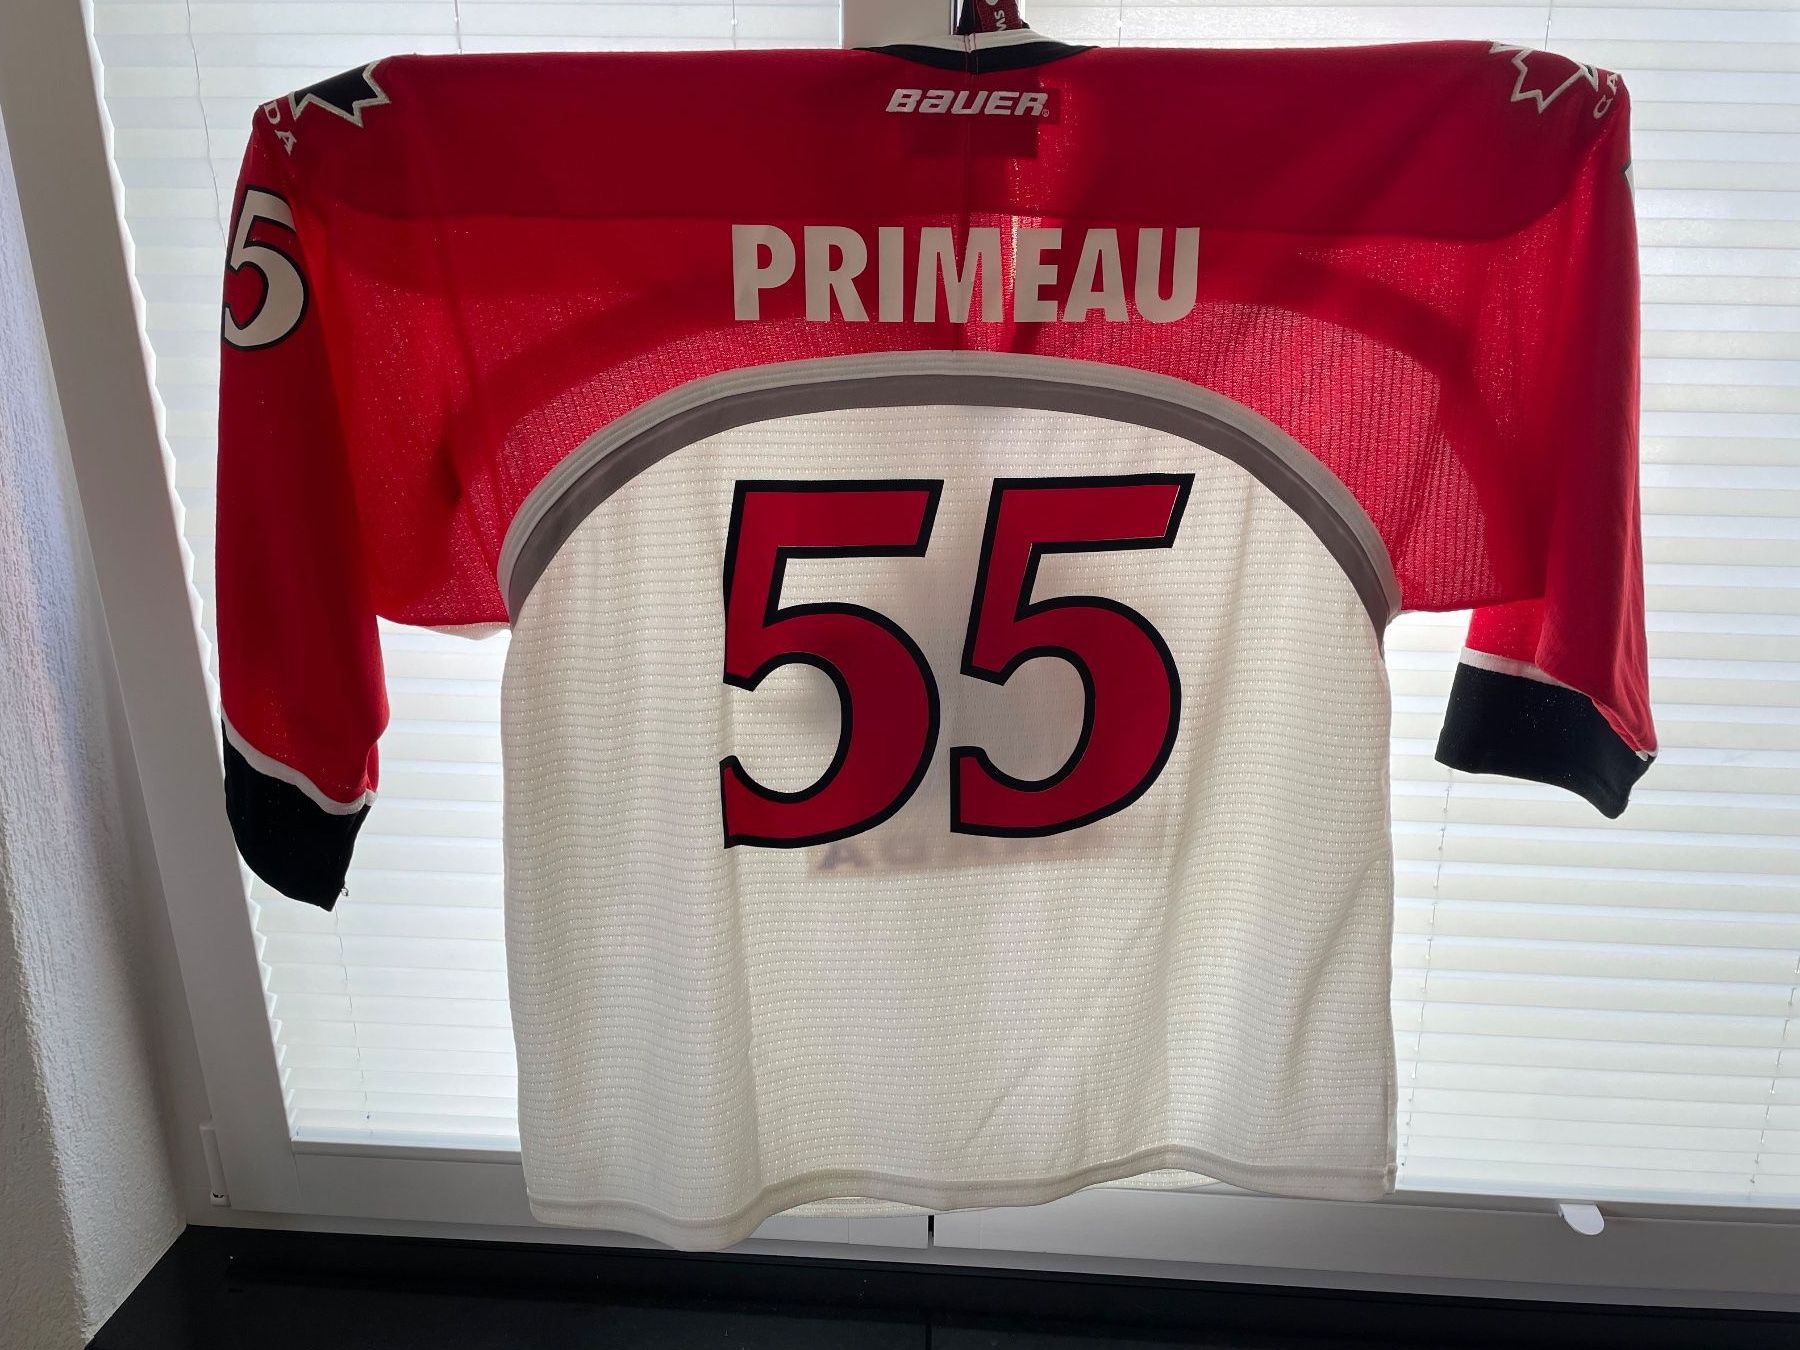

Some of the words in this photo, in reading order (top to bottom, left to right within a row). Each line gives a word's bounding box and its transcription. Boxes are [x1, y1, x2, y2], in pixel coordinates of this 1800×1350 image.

[221, 187, 309, 350] 5
[731, 223, 1200, 323] PRIMEAU
[719, 473, 1195, 849] 55
